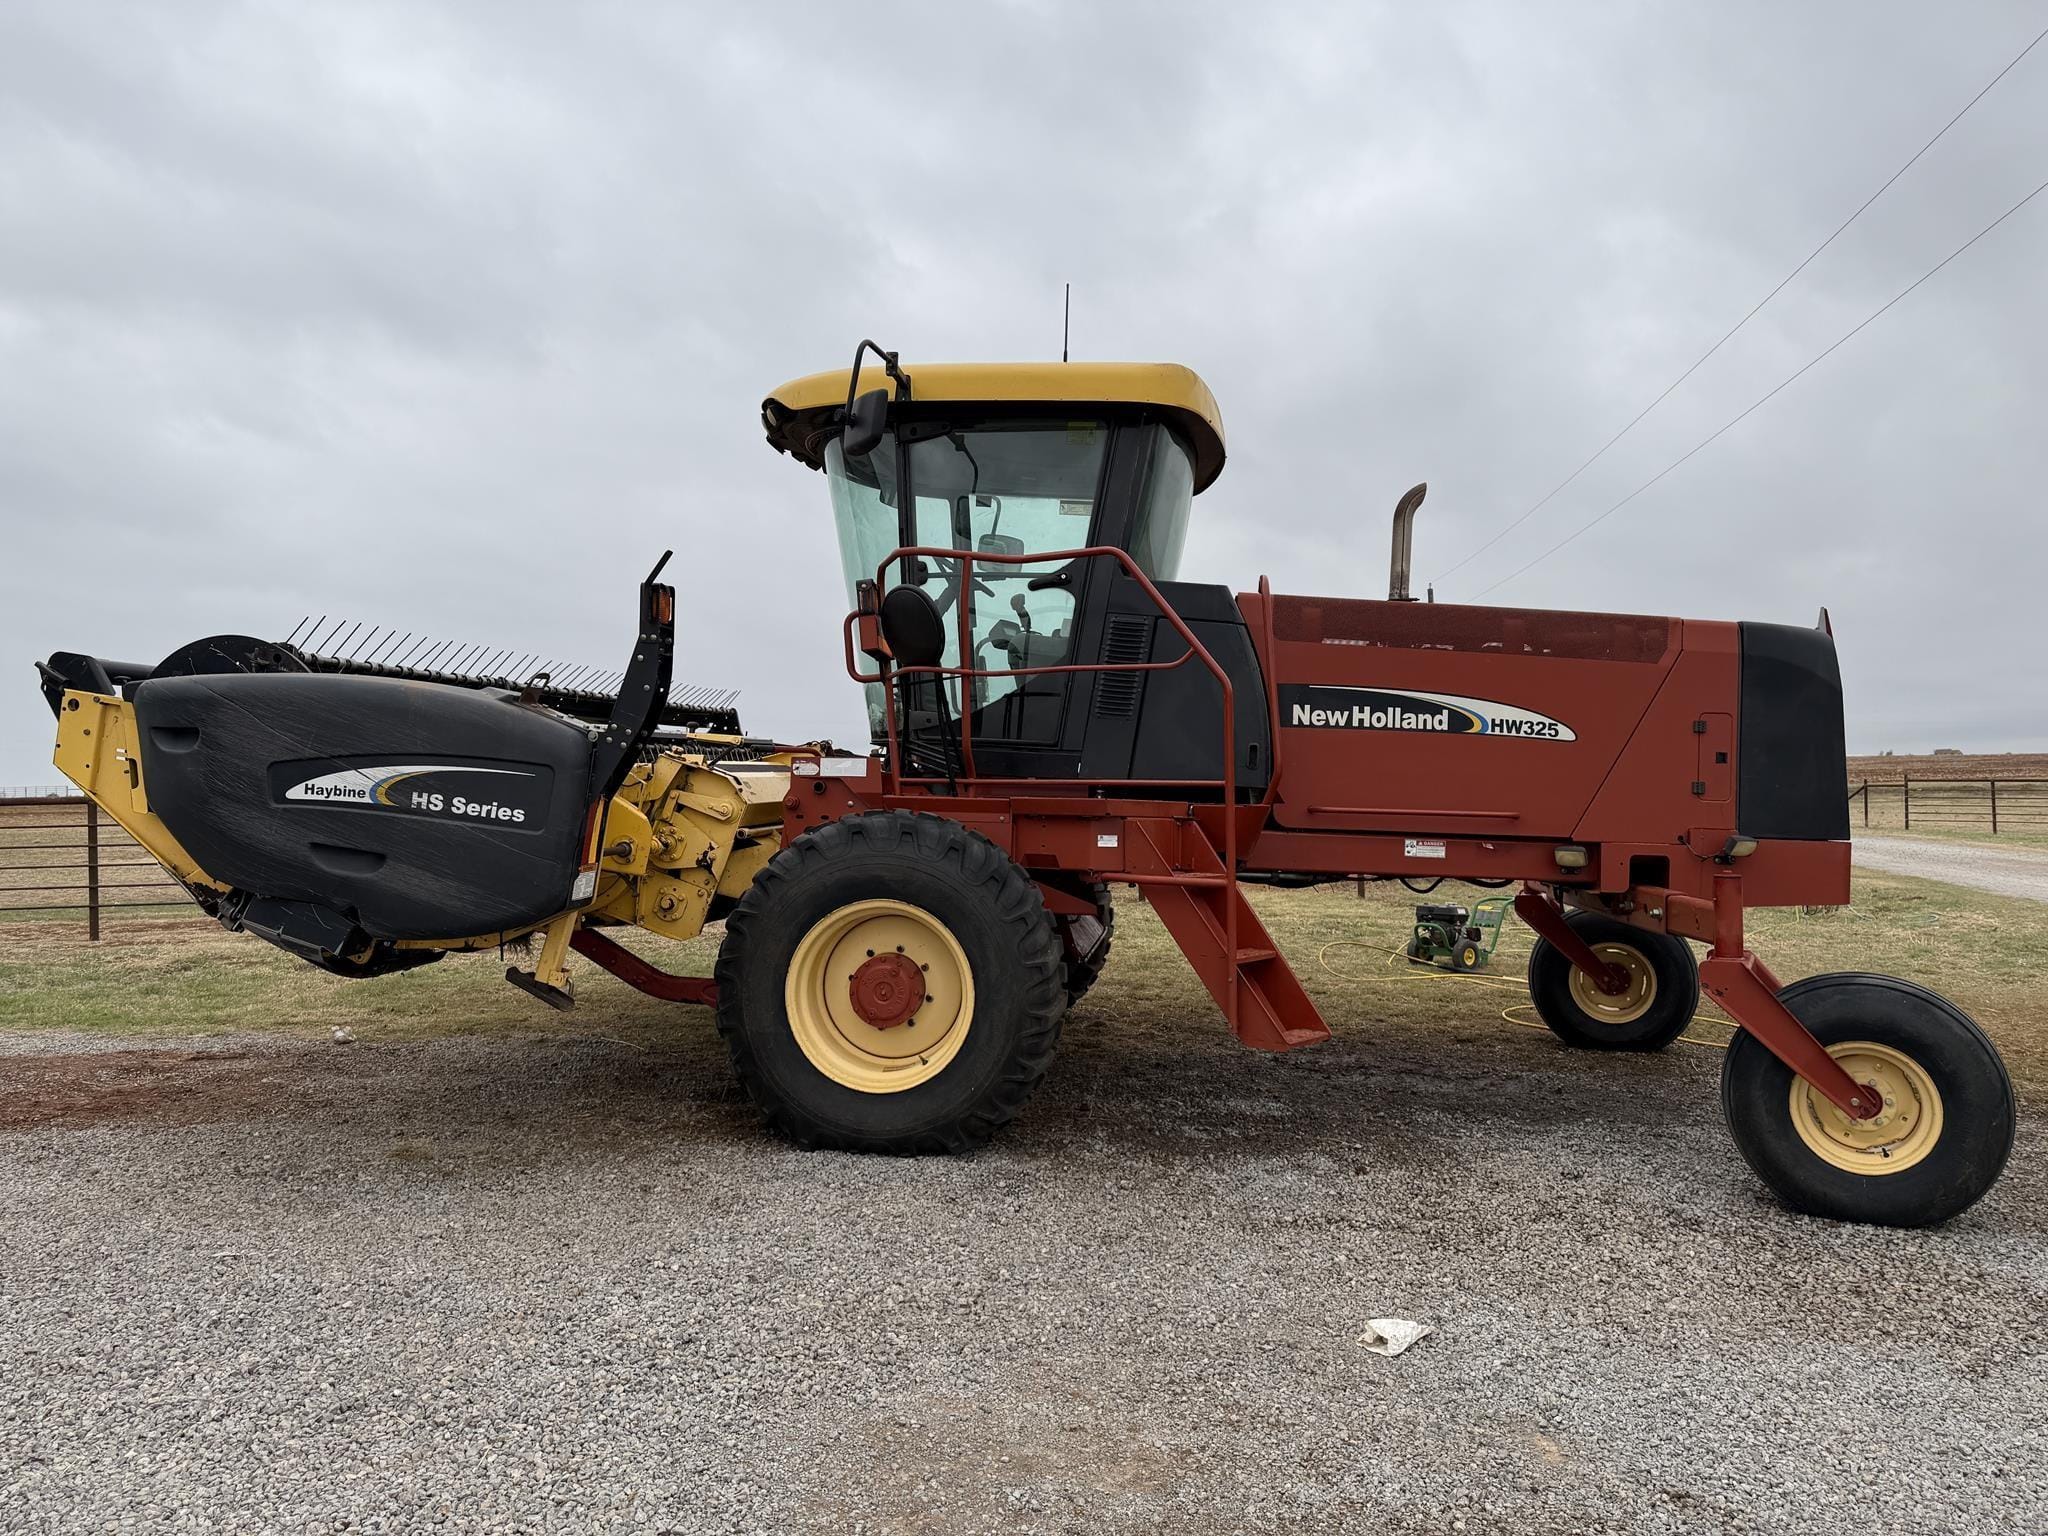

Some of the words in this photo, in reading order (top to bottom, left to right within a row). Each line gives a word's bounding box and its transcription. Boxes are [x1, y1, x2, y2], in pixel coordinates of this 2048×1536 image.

[1292, 704, 1348, 727] New
[1352, 706, 1449, 731] Holland
[1490, 718, 1559, 738] HW325
[304, 784, 367, 799] Haybine
[411, 792, 444, 812] HS
[450, 797, 526, 823] Series
